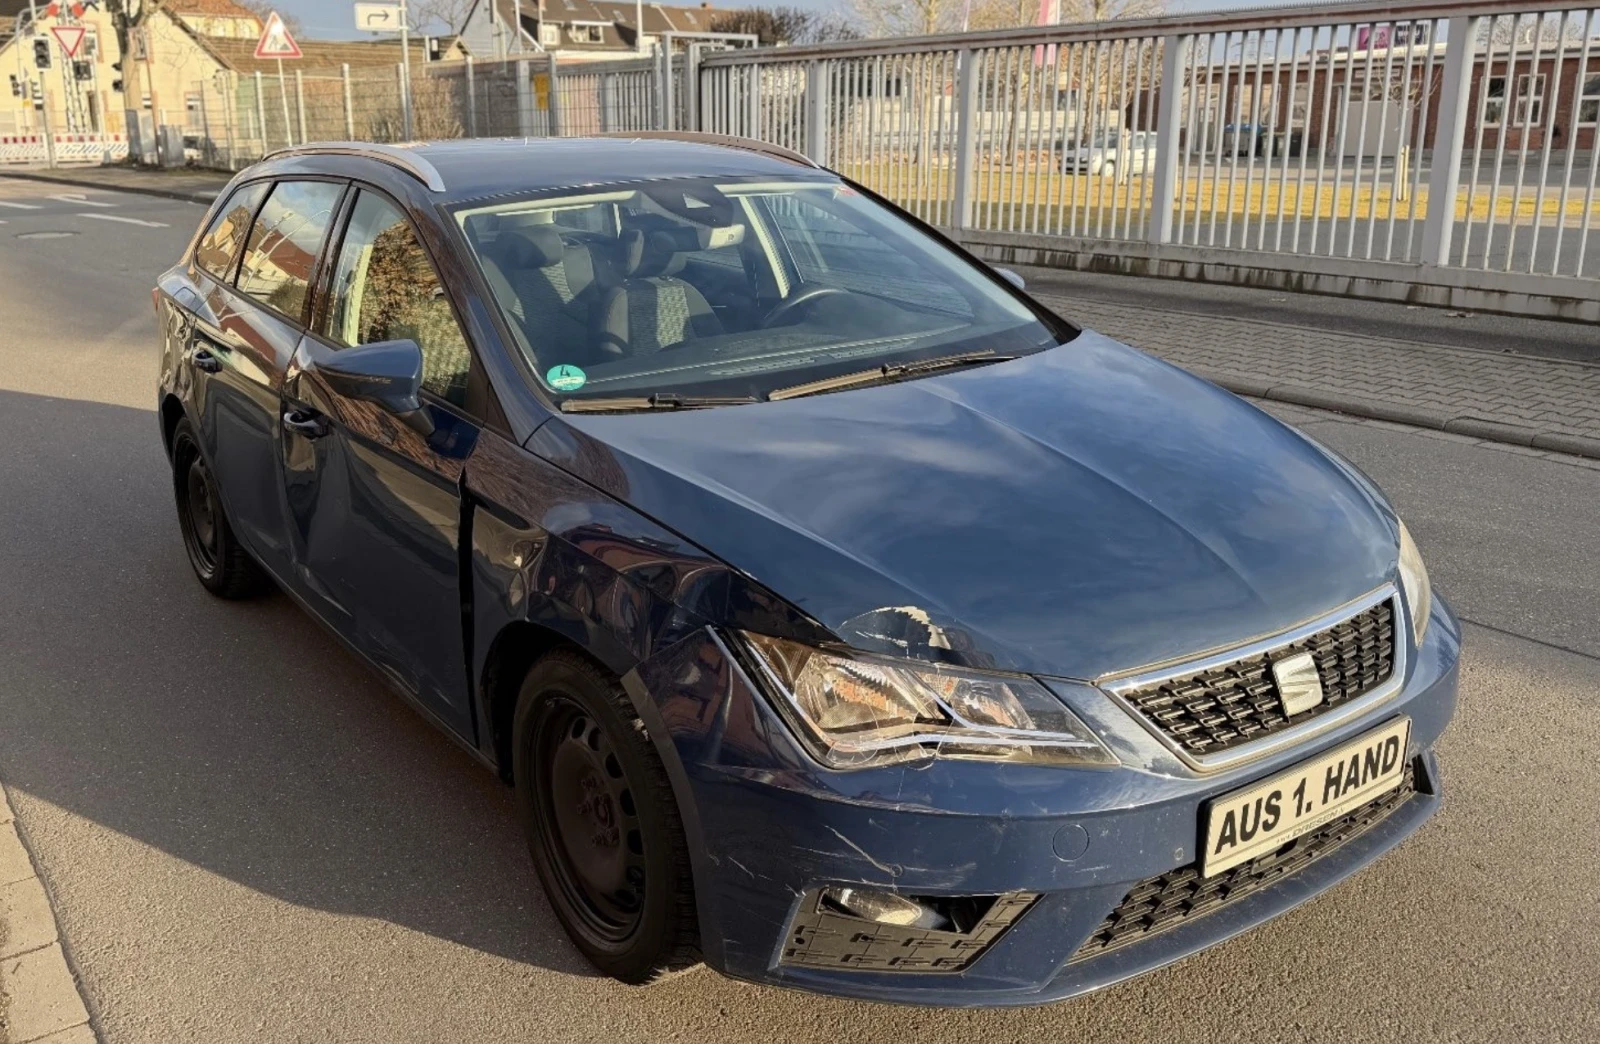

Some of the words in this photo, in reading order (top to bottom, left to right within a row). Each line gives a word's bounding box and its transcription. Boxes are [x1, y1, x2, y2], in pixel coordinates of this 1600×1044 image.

[560, 365, 571, 377] 4
[1214, 790, 1282, 855] AUS
[1293, 777, 1313, 818] 1.
[1321, 735, 1400, 806] HAND
